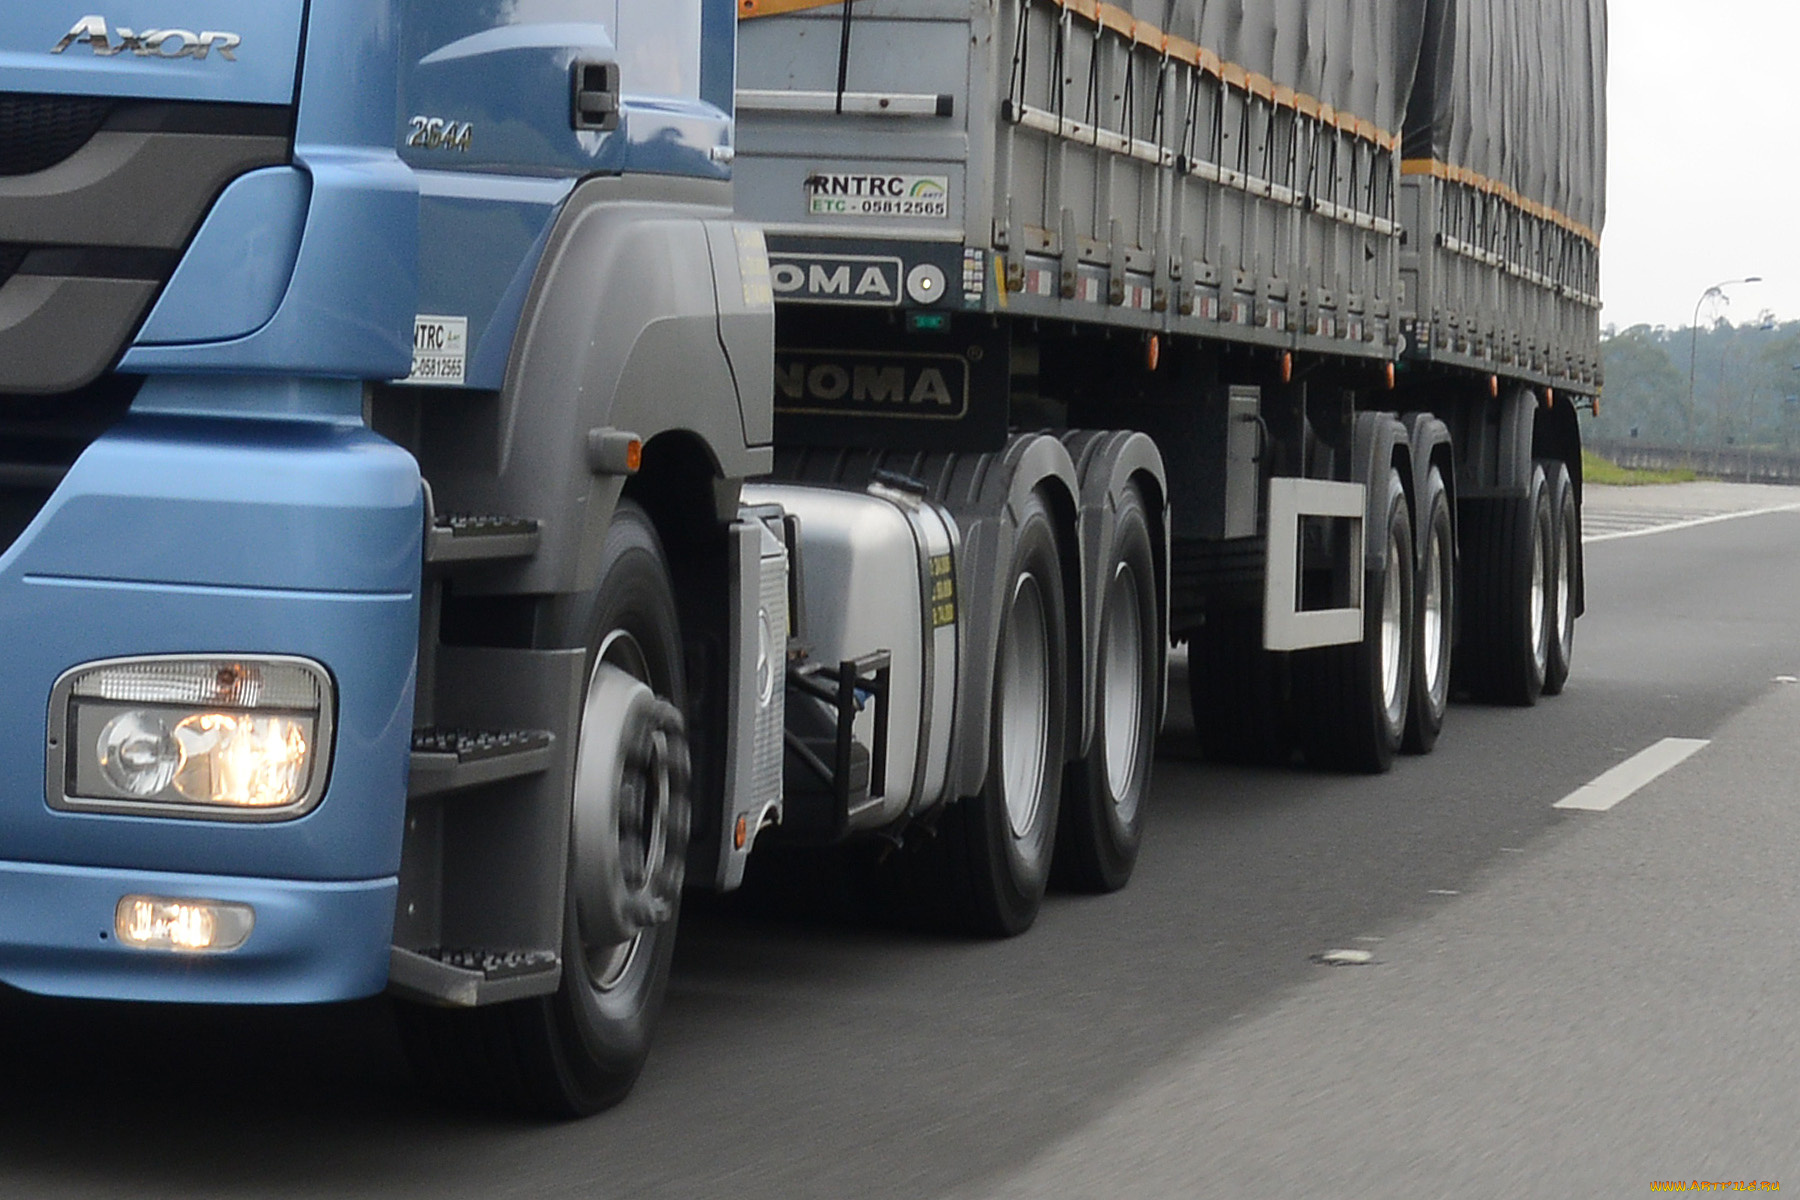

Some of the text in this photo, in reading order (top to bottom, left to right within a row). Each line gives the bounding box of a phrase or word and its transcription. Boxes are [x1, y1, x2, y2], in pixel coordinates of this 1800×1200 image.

[406, 115, 473, 152] 2644
[812, 176, 904, 197] RNTRC
[812, 200, 846, 212] ETC
